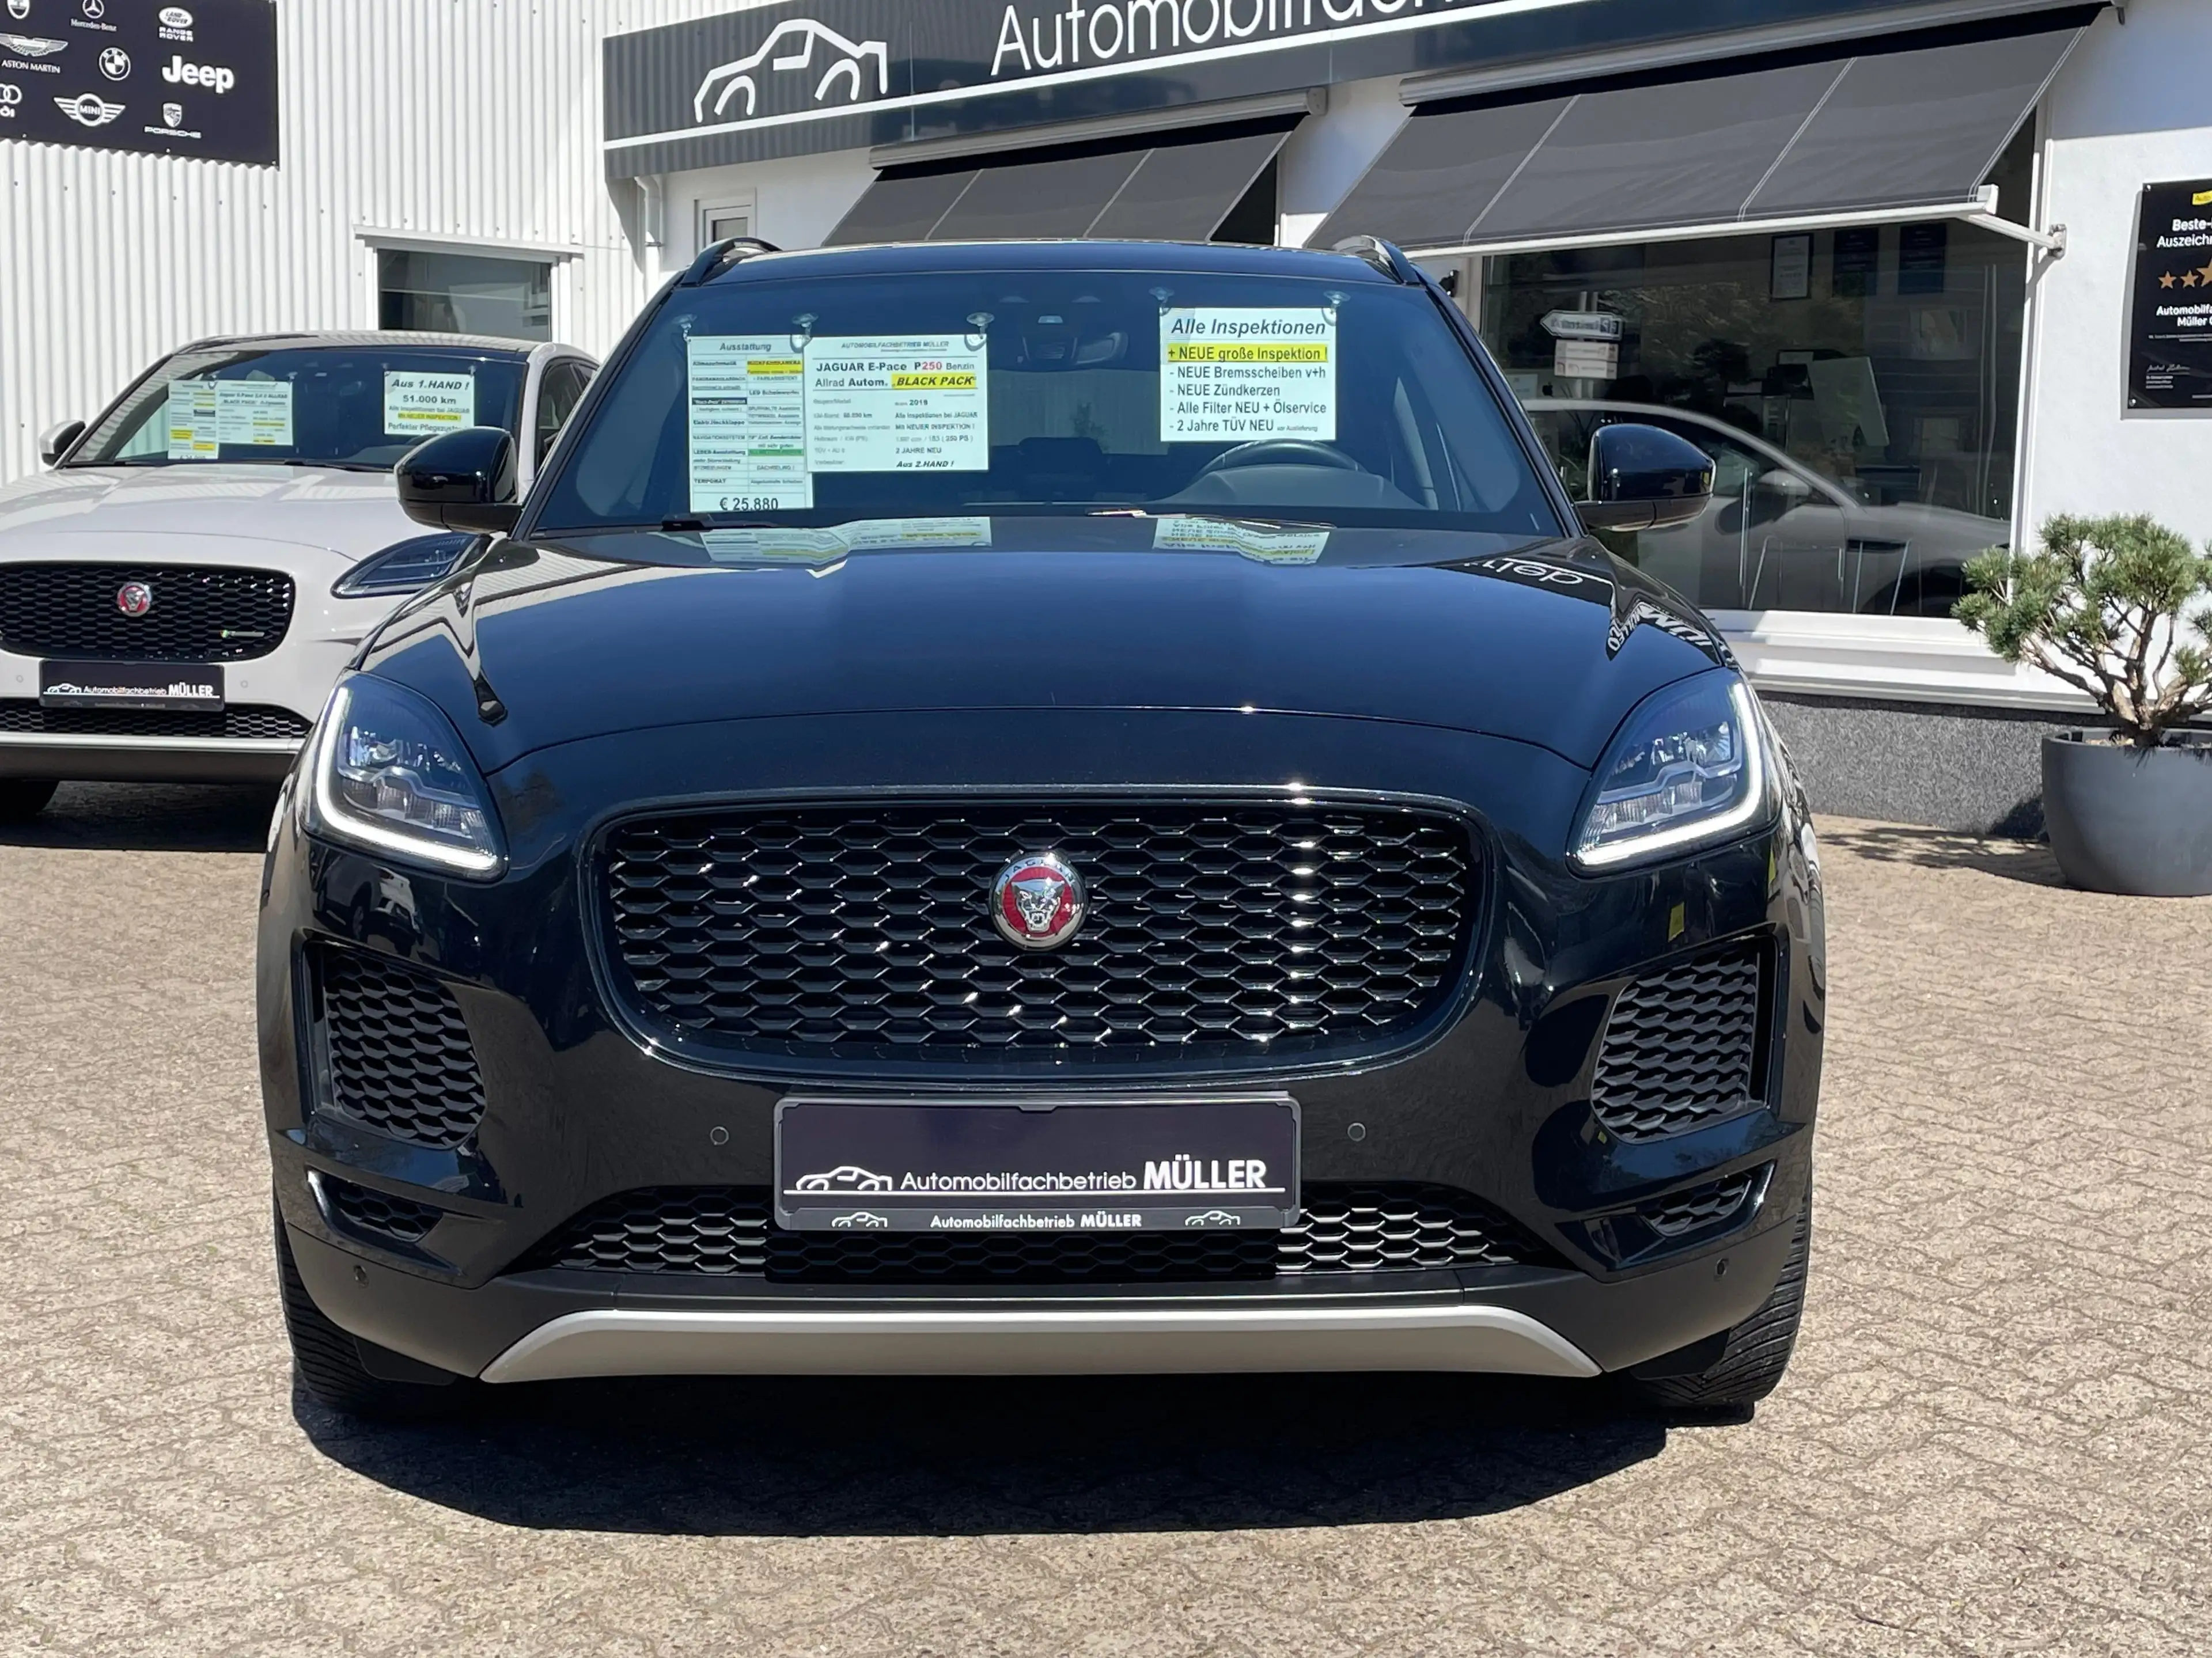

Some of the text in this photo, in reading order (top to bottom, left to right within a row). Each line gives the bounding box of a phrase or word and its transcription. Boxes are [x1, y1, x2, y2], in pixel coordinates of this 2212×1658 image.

[70, 18, 117, 32] Mercedes-Benz
[159, 26, 193, 36] RANGE
[159, 32, 194, 42] ROVER
[990, 0, 1452, 75] Automobi
[2, 59, 60, 74] ASTON MARTIN
[162, 56, 234, 93] Jeep
[79, 105, 101, 115] MINI
[144, 126, 201, 139] PORSCHE
[2172, 218, 2212, 232] Beste-
[1172, 318, 1325, 338] Alle Inspektionen
[2177, 316, 2207, 327] Müller
[720, 343, 771, 352] Ausstattung
[1179, 347, 1214, 359] NEUE
[1218, 347, 1253, 362] große
[1257, 347, 1320, 362] Inspektion
[816, 361, 975, 372] JAGUAR E-Pace P250 Benzin
[1177, 366, 1210, 378] NEUE
[1214, 366, 1302, 378] Bremsscheiben
[1306, 366, 1326, 378] v+h
[392, 379, 414, 388] Aus
[418, 380, 462, 390] 1.HAND
[815, 378, 844, 388] Allrad
[848, 377, 888, 387] Autom.
[1177, 384, 1210, 396] NEUE
[1214, 384, 1281, 396] Zündkerzen
[1177, 401, 1199, 413] Alle
[1203, 401, 1232, 413] Filter
[1236, 401, 1259, 413] NEU
[1274, 399, 1327, 413] Ölservice
[1177, 420, 1184, 431] 2
[1187, 420, 1219, 431] Jahre
[1222, 416, 1246, 431] TÜV
[1249, 420, 1274, 431] NEU
[719, 497, 778, 511] € 25.880
[168, 682, 214, 697] MÜLLER
[900, 1155, 1266, 1192] Automobilfachbetrieb MÜLLER
[930, 1211, 1142, 1229] Automobilfachbetrieb MÜLLER
